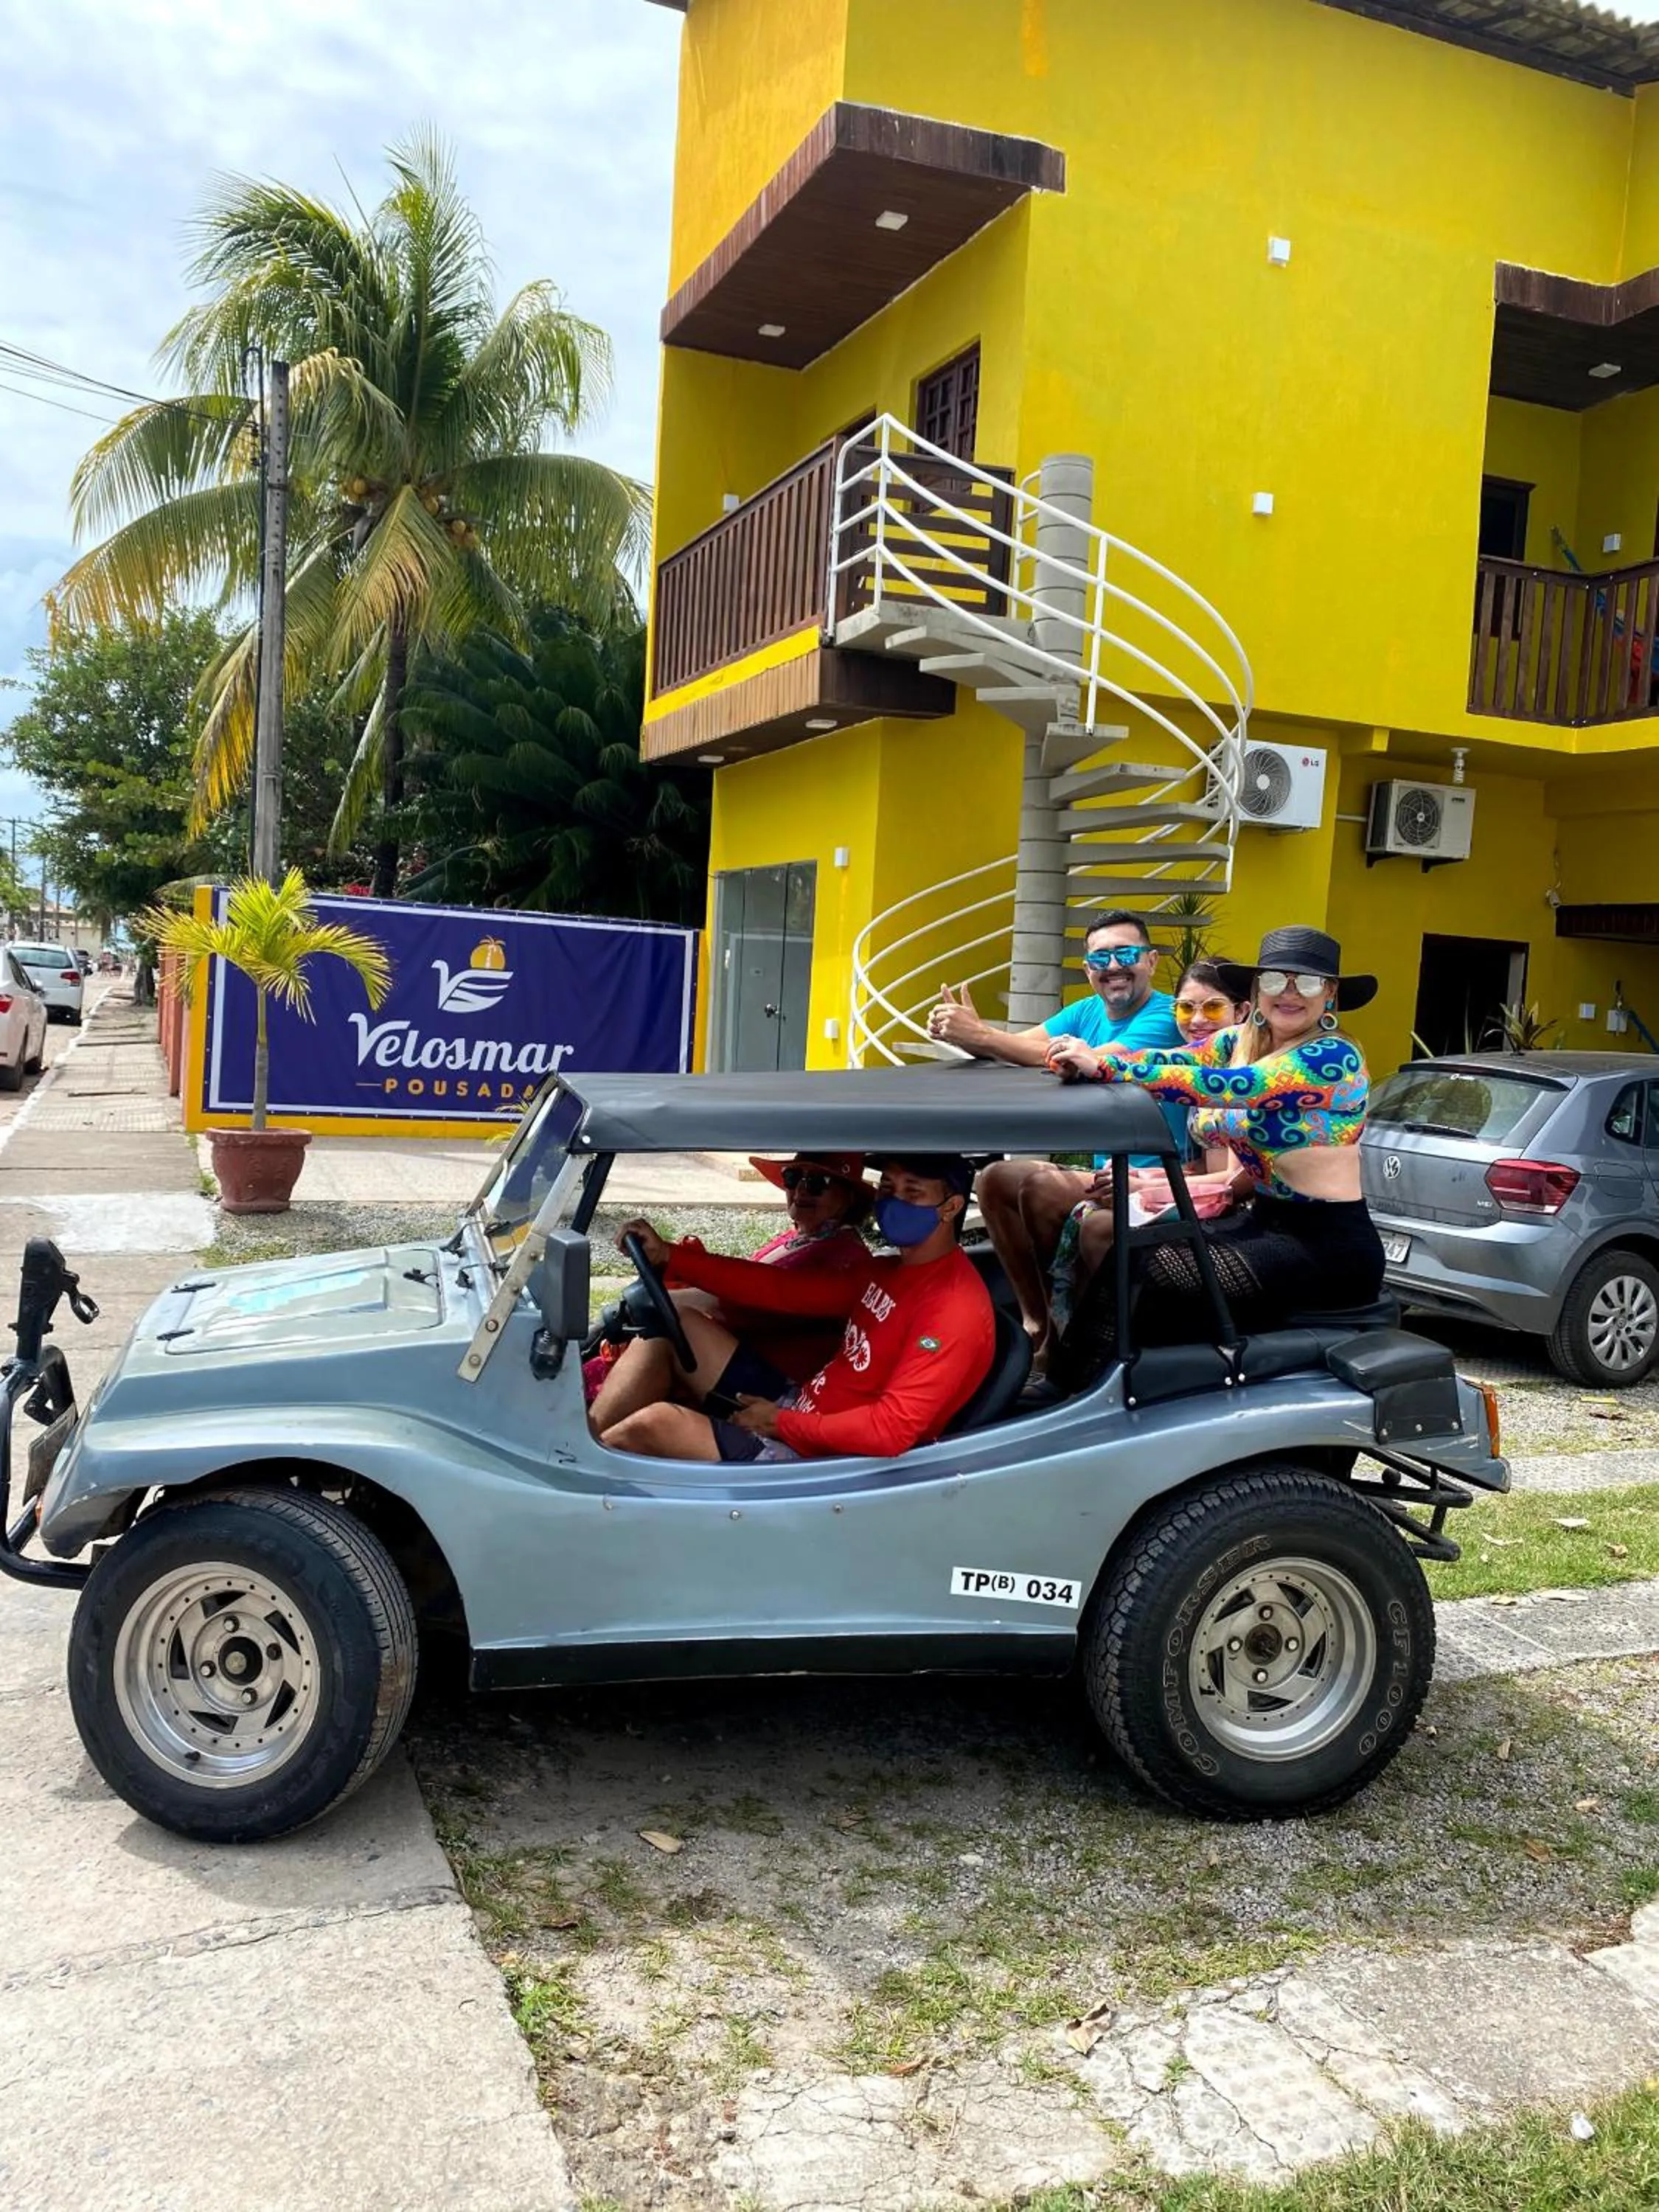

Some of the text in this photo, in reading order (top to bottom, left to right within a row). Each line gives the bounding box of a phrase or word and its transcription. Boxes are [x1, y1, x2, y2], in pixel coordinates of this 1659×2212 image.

[1310, 759, 1320, 767] LG
[348, 1012, 574, 1074] Velosmar
[384, 1079, 535, 1099] POUSADA
[961, 1571, 1074, 1604] TP(B) 034
